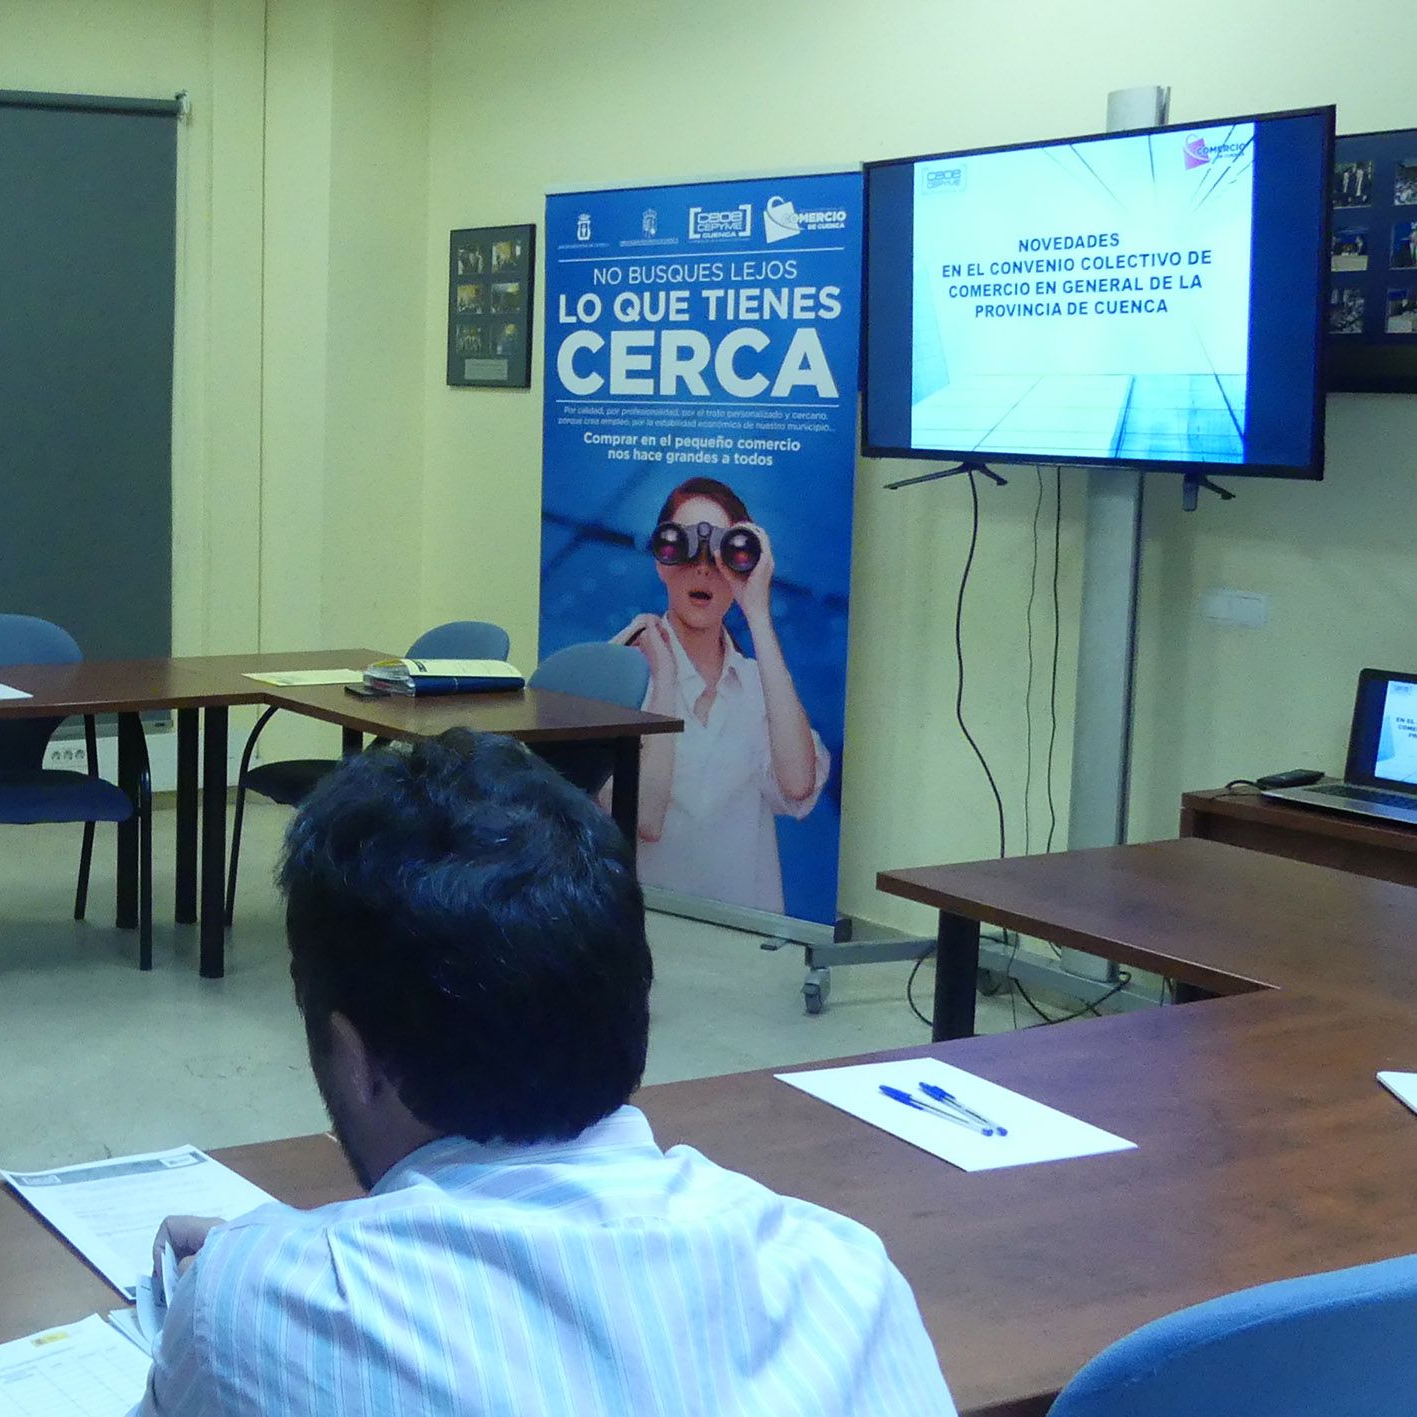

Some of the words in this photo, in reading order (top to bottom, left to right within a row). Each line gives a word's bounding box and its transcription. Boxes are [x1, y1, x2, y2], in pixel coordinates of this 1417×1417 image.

[697, 222, 743, 232] CEPYME
[784, 211, 847, 225] COMERCIO
[702, 231, 736, 239] CUENCA
[1018, 232, 1120, 253] NOVEDADES
[593, 267, 622, 286] NO
[628, 263, 724, 284] BUSQUES
[730, 260, 797, 281] LEJOS
[941, 264, 962, 278] EN
[967, 263, 985, 277] EL
[989, 257, 1075, 276] CONVENIO
[1080, 252, 1182, 272] COLECTIVO
[1188, 250, 1213, 265] DE
[948, 281, 1031, 299] COMERCIO
[1035, 280, 1057, 295] EN
[1062, 276, 1144, 294] GENERAL
[1150, 275, 1173, 291] DE
[1179, 274, 1203, 290] LA
[559, 293, 602, 324] LO
[613, 290, 690, 322] QUE
[701, 286, 842, 321] TIENES
[975, 302, 1063, 319] PROVINCIA
[1067, 301, 1089, 316] DE
[1094, 299, 1168, 315] CUENCA
[556, 327, 839, 399] CERCA
[583, 432, 638, 447] Comprar
[640, 436, 656, 446] en
[659, 434, 671, 446] el
[675, 435, 733, 450] pequeño
[737, 438, 801, 451] comercio
[607, 449, 630, 460] nos
[633, 448, 662, 461] hace
[665, 450, 719, 464] grandes
[721, 454, 730, 464] a
[733, 452, 773, 466] todos
